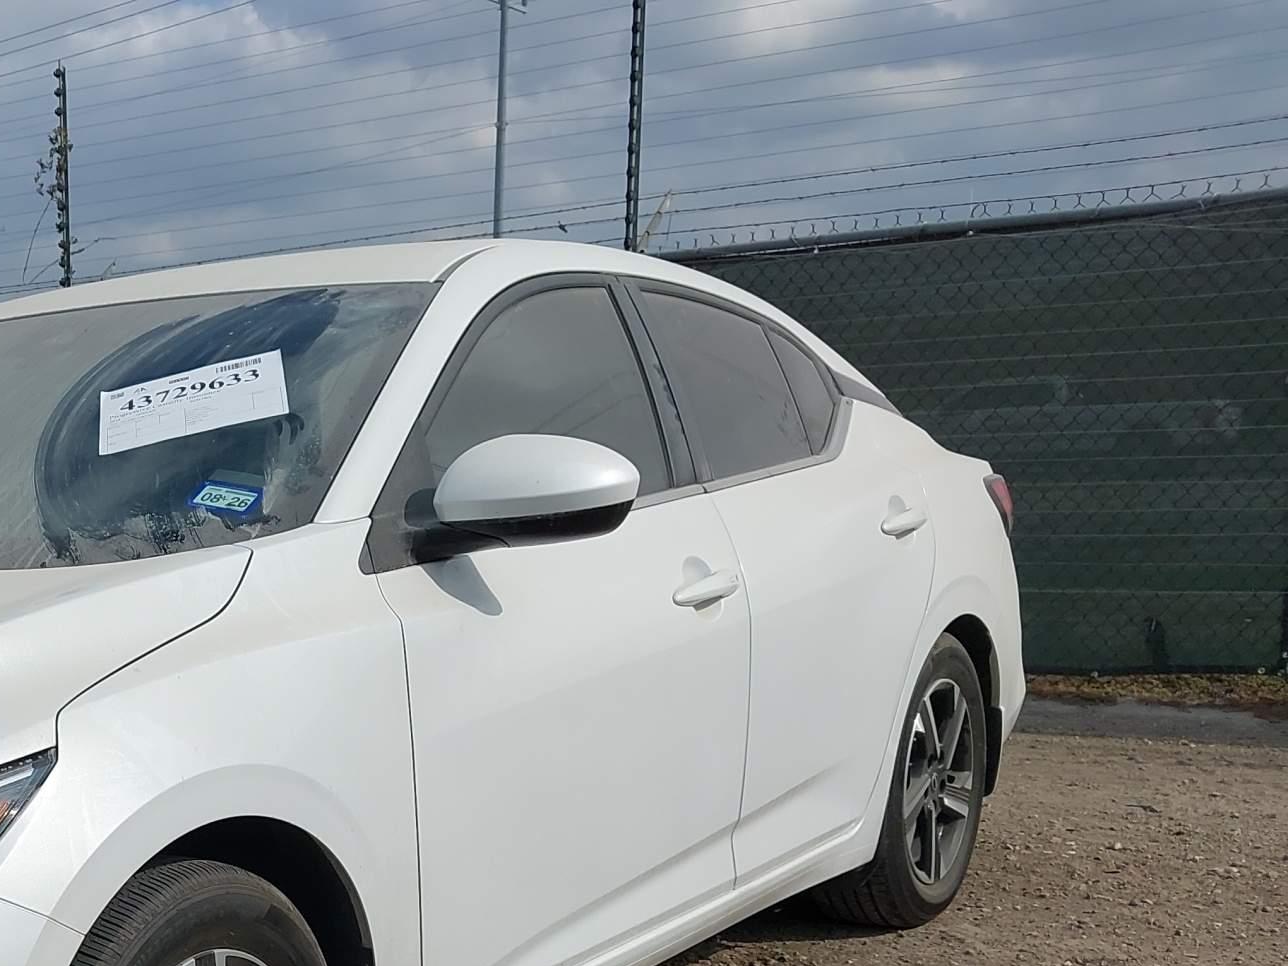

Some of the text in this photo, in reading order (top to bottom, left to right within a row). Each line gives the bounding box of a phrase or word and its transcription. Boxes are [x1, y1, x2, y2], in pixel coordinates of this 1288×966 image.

[119, 369, 260, 411] 43729633
[201, 492, 251, 508] 08 26
